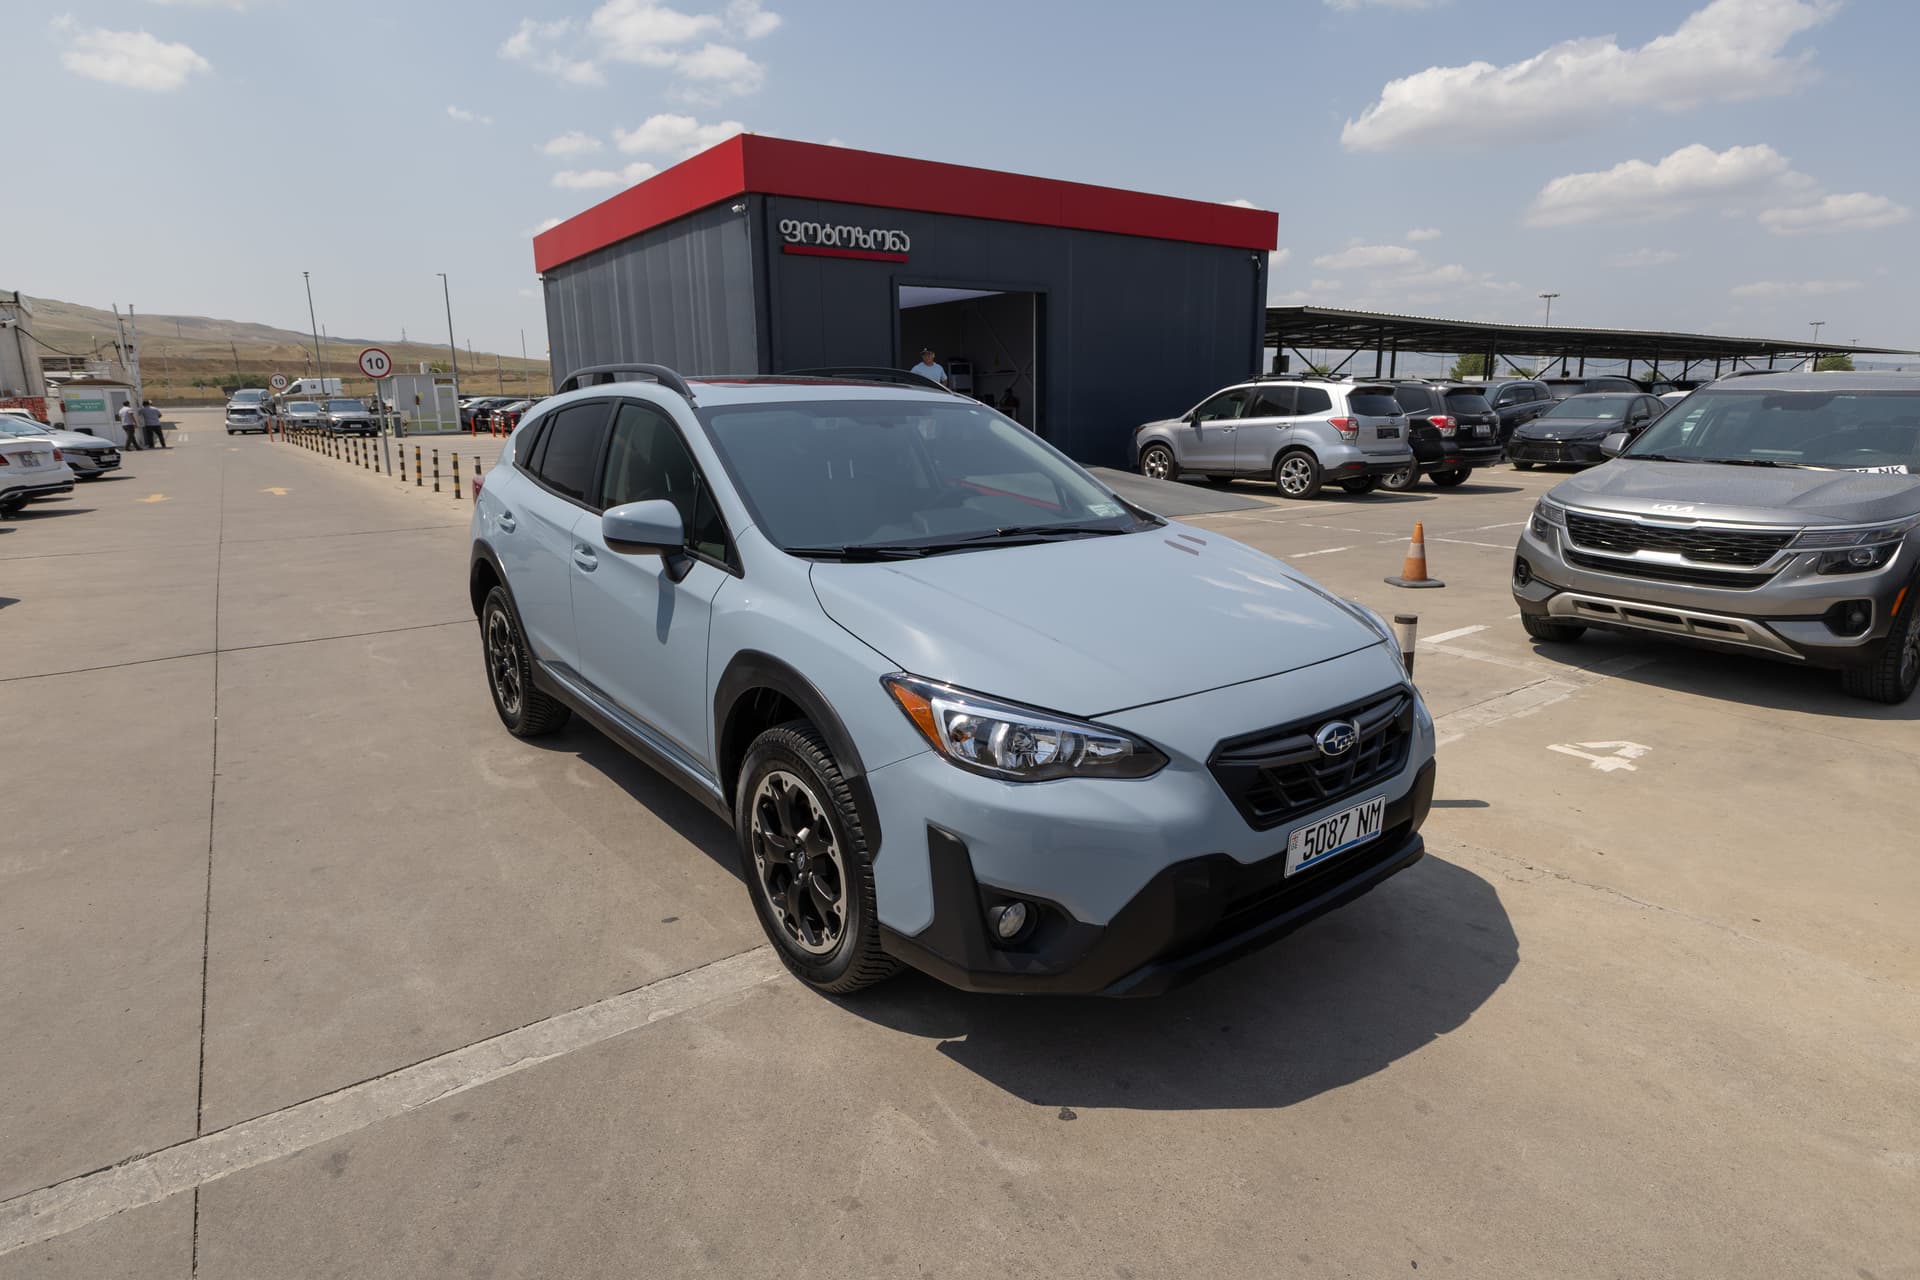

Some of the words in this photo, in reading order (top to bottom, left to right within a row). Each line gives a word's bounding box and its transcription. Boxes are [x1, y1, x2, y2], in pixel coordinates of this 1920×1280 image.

[780, 219, 911, 252] ფოტოზონა
[366, 357, 385, 370] 10
[1303, 812, 1351, 861] 5087
[1356, 800, 1382, 838] NM
